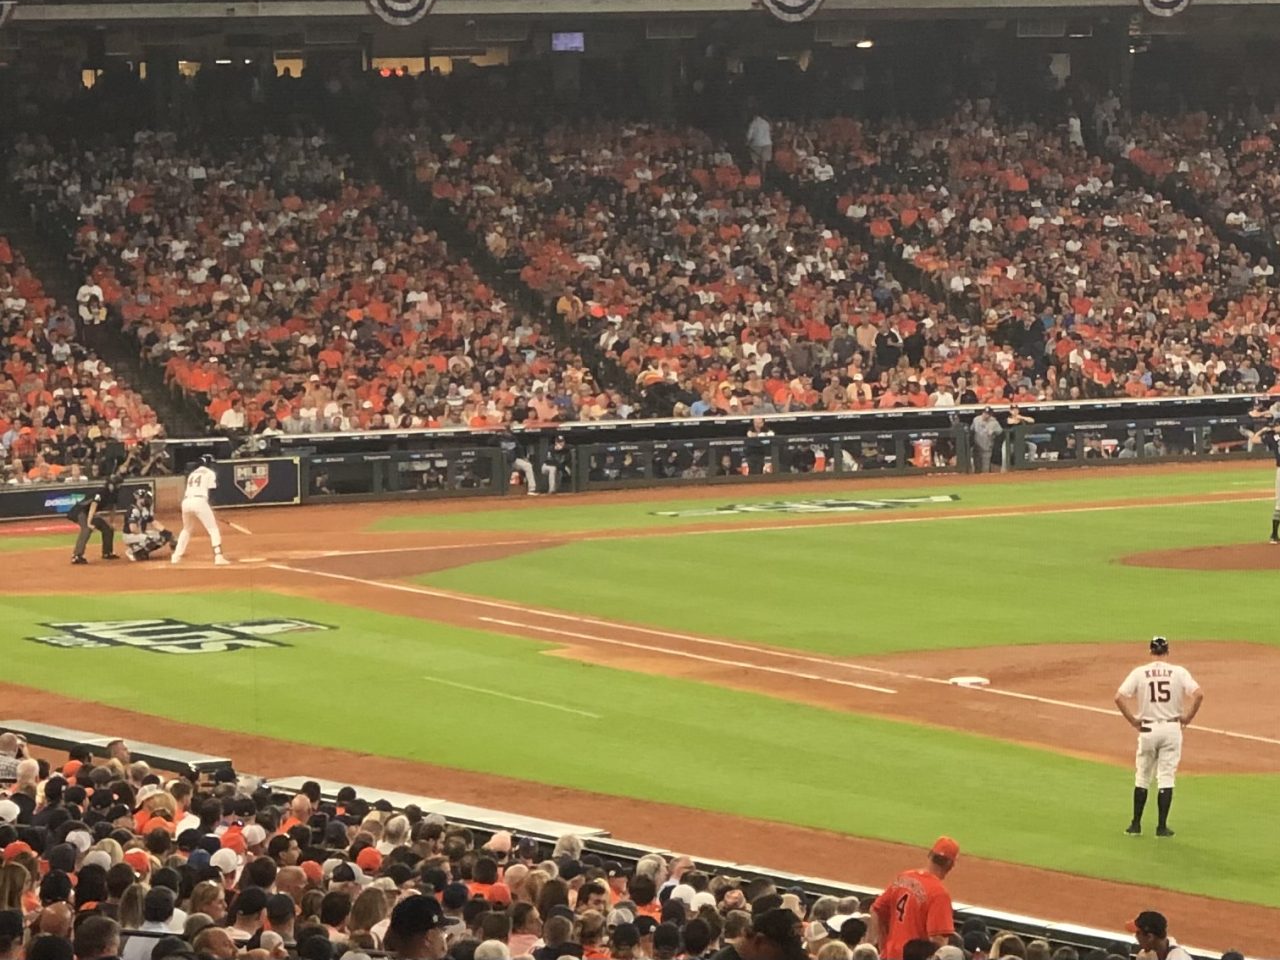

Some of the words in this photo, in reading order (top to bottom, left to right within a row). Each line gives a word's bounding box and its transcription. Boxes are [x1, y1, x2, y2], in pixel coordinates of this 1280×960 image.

[187, 474, 203, 487] 44
[1149, 681, 1171, 703] 15
[896, 893, 909, 922] 4
